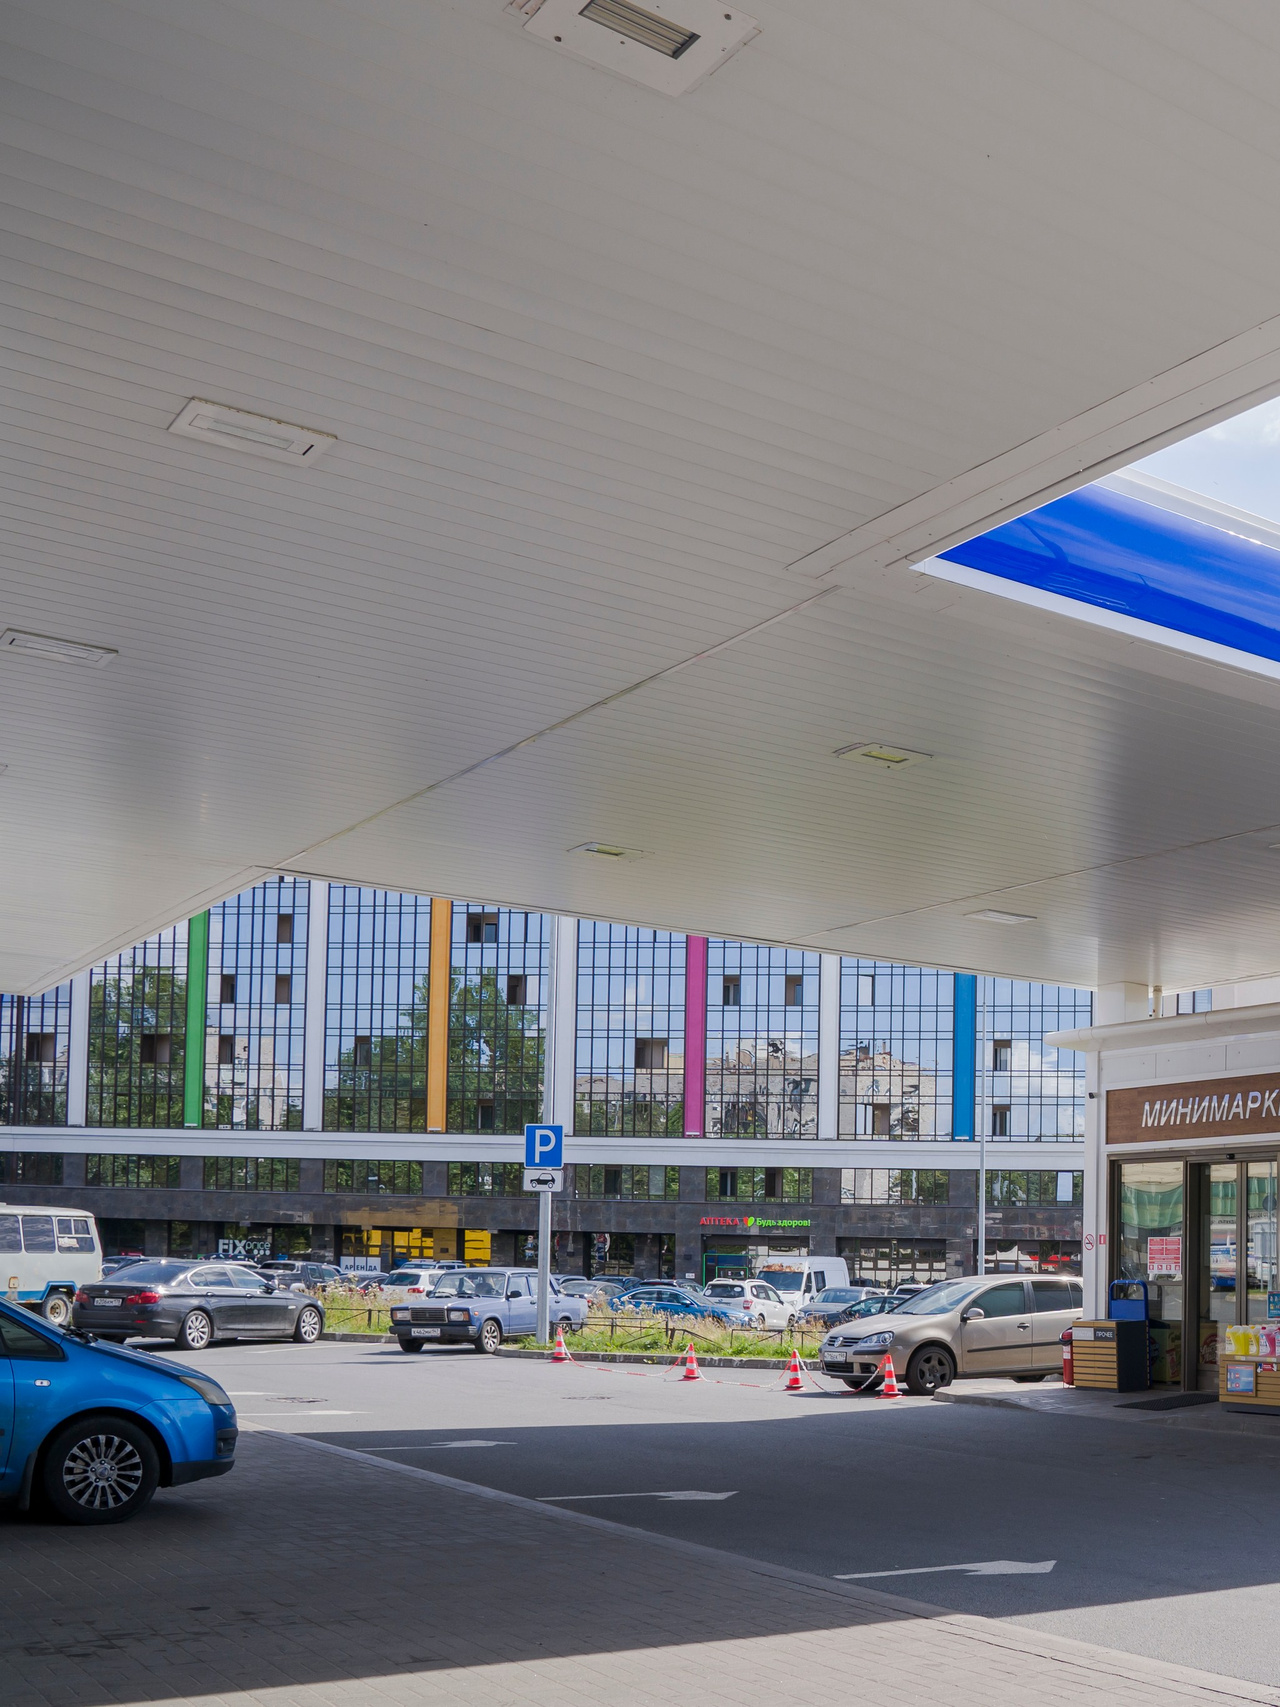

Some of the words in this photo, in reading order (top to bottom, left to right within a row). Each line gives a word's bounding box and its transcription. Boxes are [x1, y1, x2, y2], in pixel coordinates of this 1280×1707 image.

[534, 1129, 556, 1163] P
[699, 1217, 740, 1226] АПТЕКА
[756, 1218, 776, 1228] Будь
[777, 1219, 811, 1228] здоров!
[246, 1241, 271, 1250] price
[344, 1264, 378, 1272] АРЕНДА
